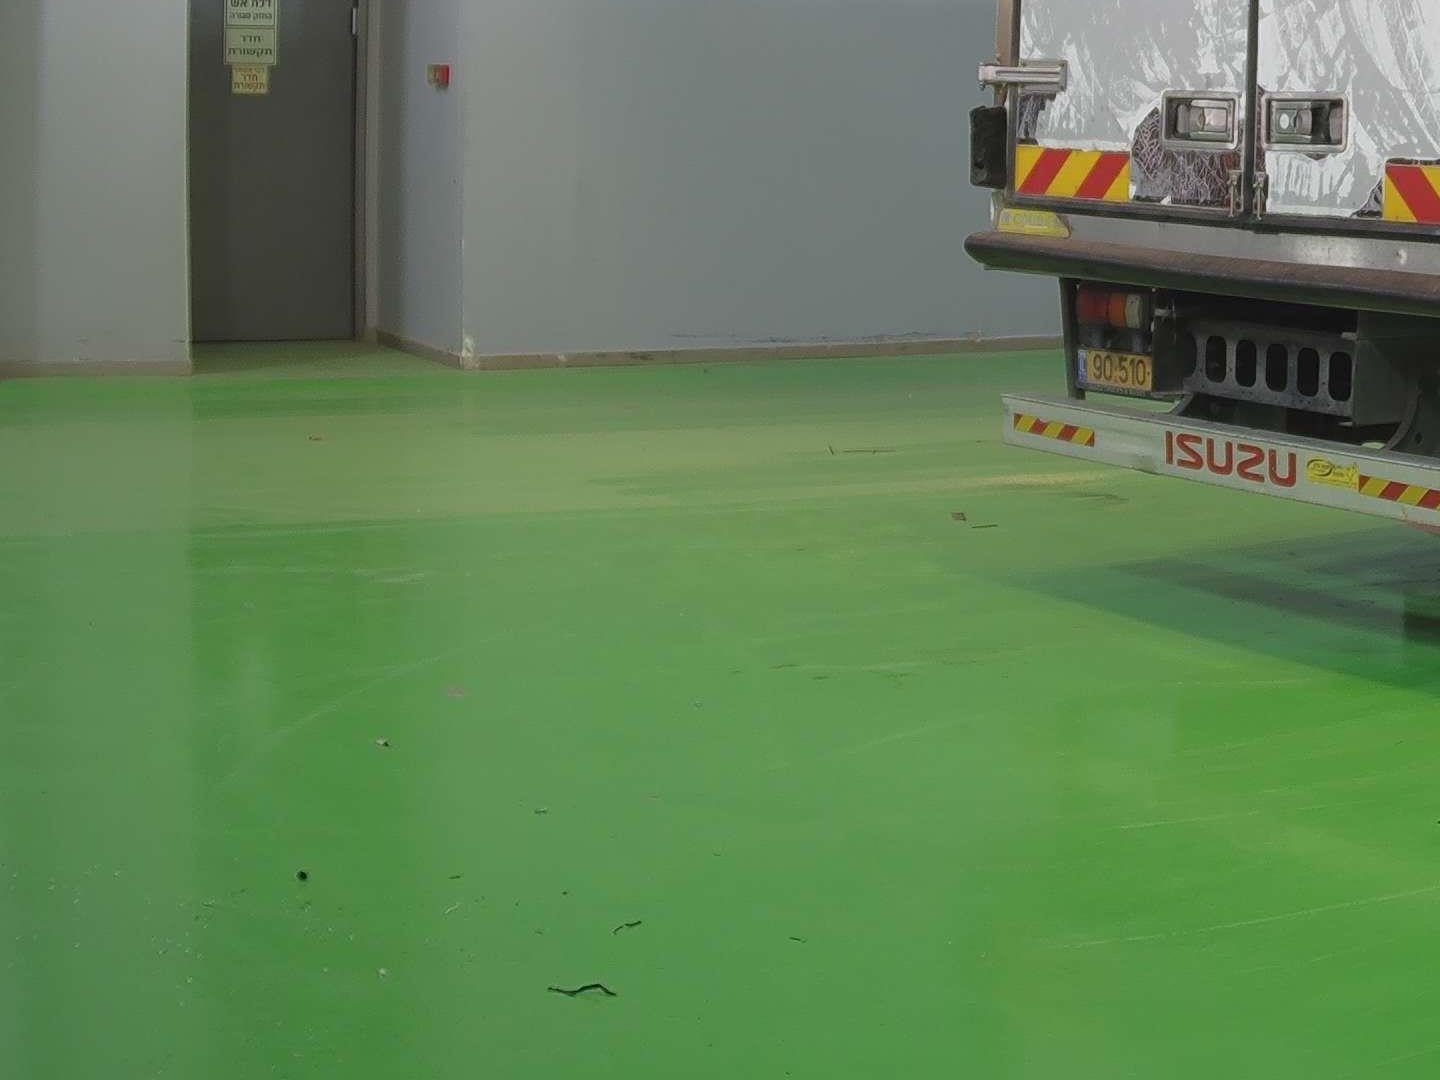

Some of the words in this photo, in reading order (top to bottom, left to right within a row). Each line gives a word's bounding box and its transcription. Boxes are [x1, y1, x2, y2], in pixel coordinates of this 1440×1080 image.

[230, 0, 248, 8] אש
[228, 47, 273, 58] תקשורת
[1165, 430, 1297, 488] ISUZU
